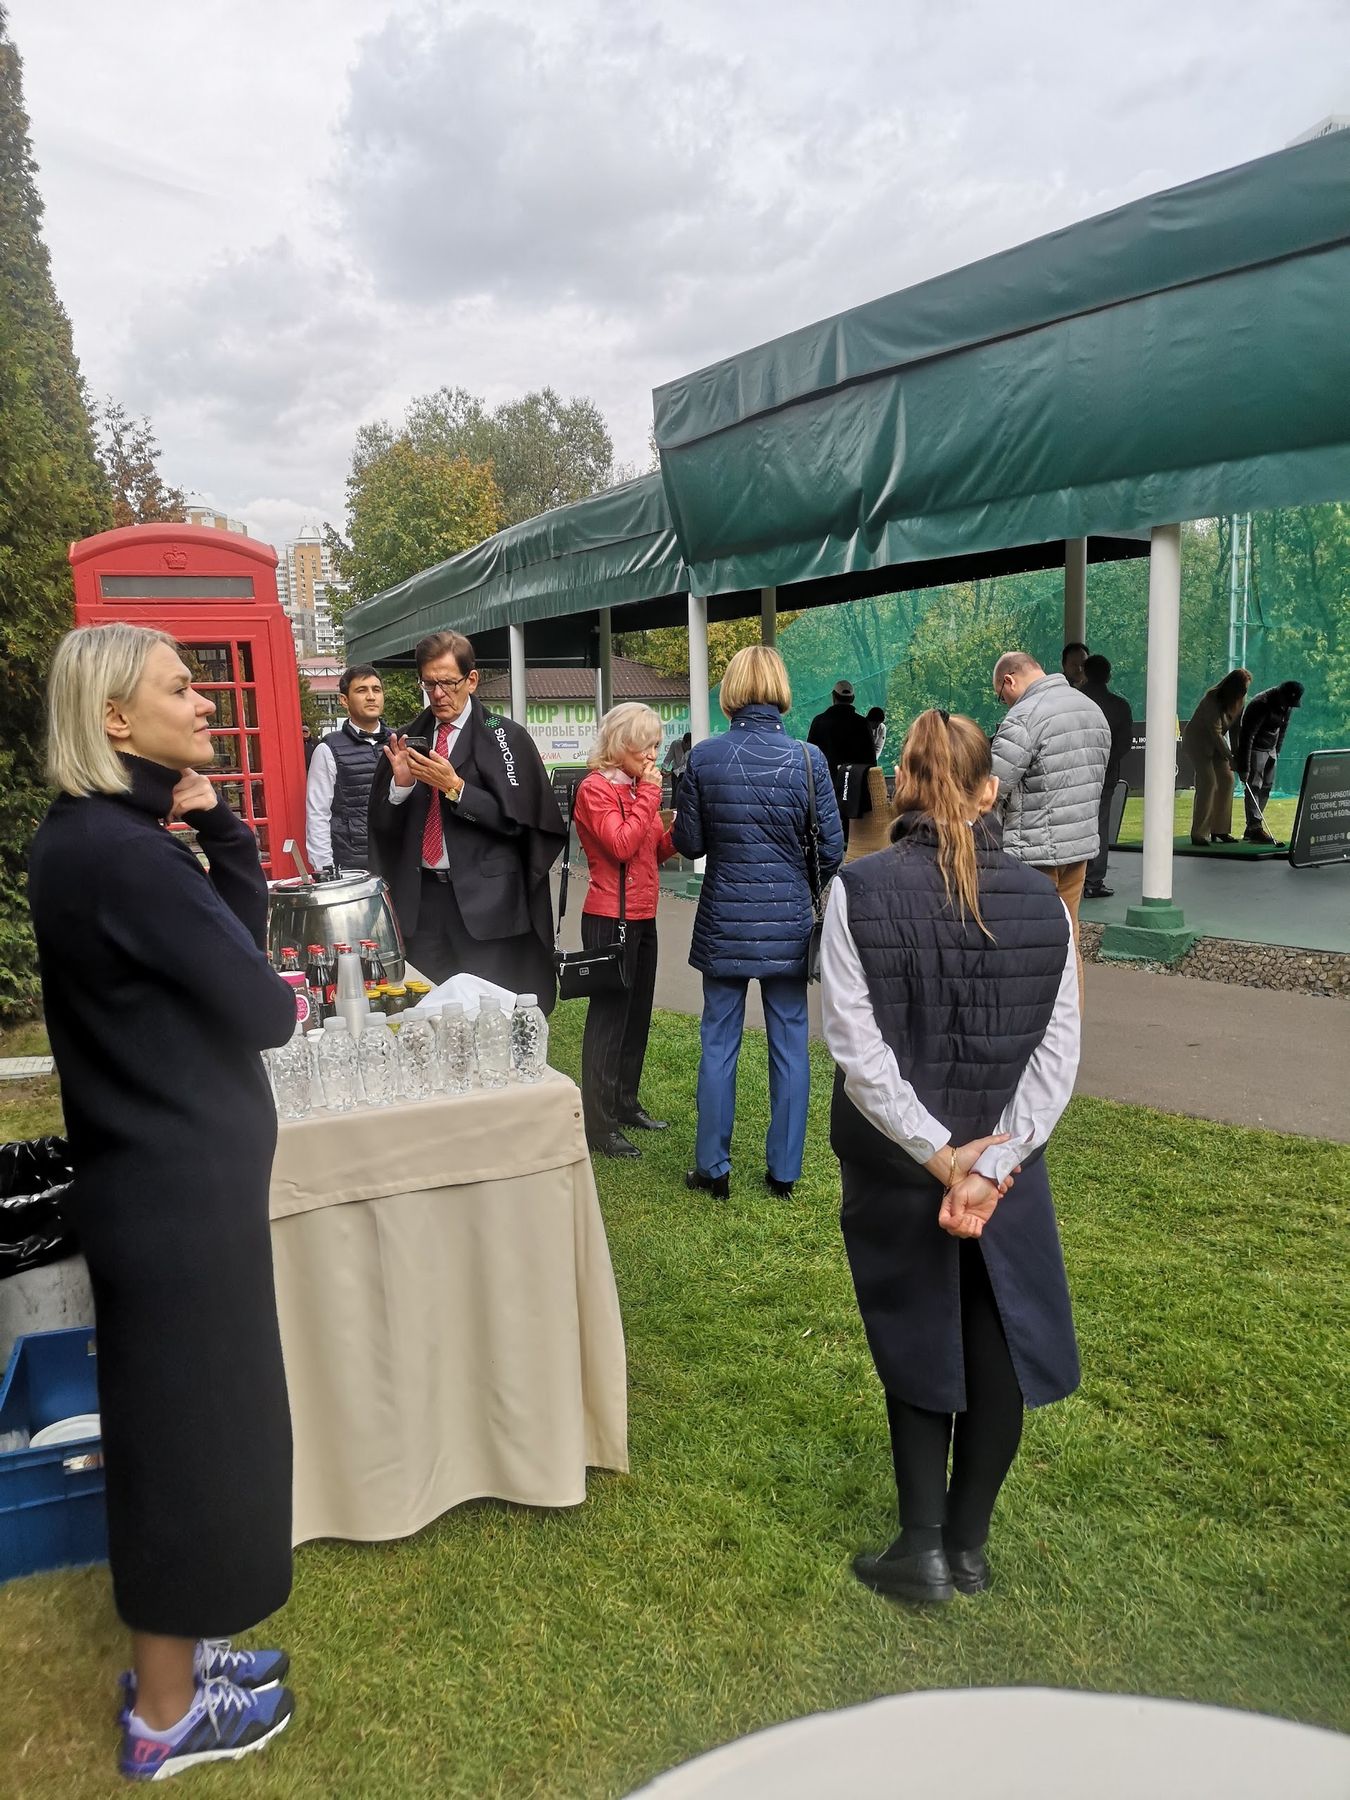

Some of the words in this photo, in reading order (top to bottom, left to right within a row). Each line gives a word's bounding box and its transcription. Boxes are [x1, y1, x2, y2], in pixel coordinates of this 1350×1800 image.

[565, 703, 596, 723] ГОЛ
[578, 725, 597, 737] БРЕ
[494, 727, 520, 786] SberCloud
